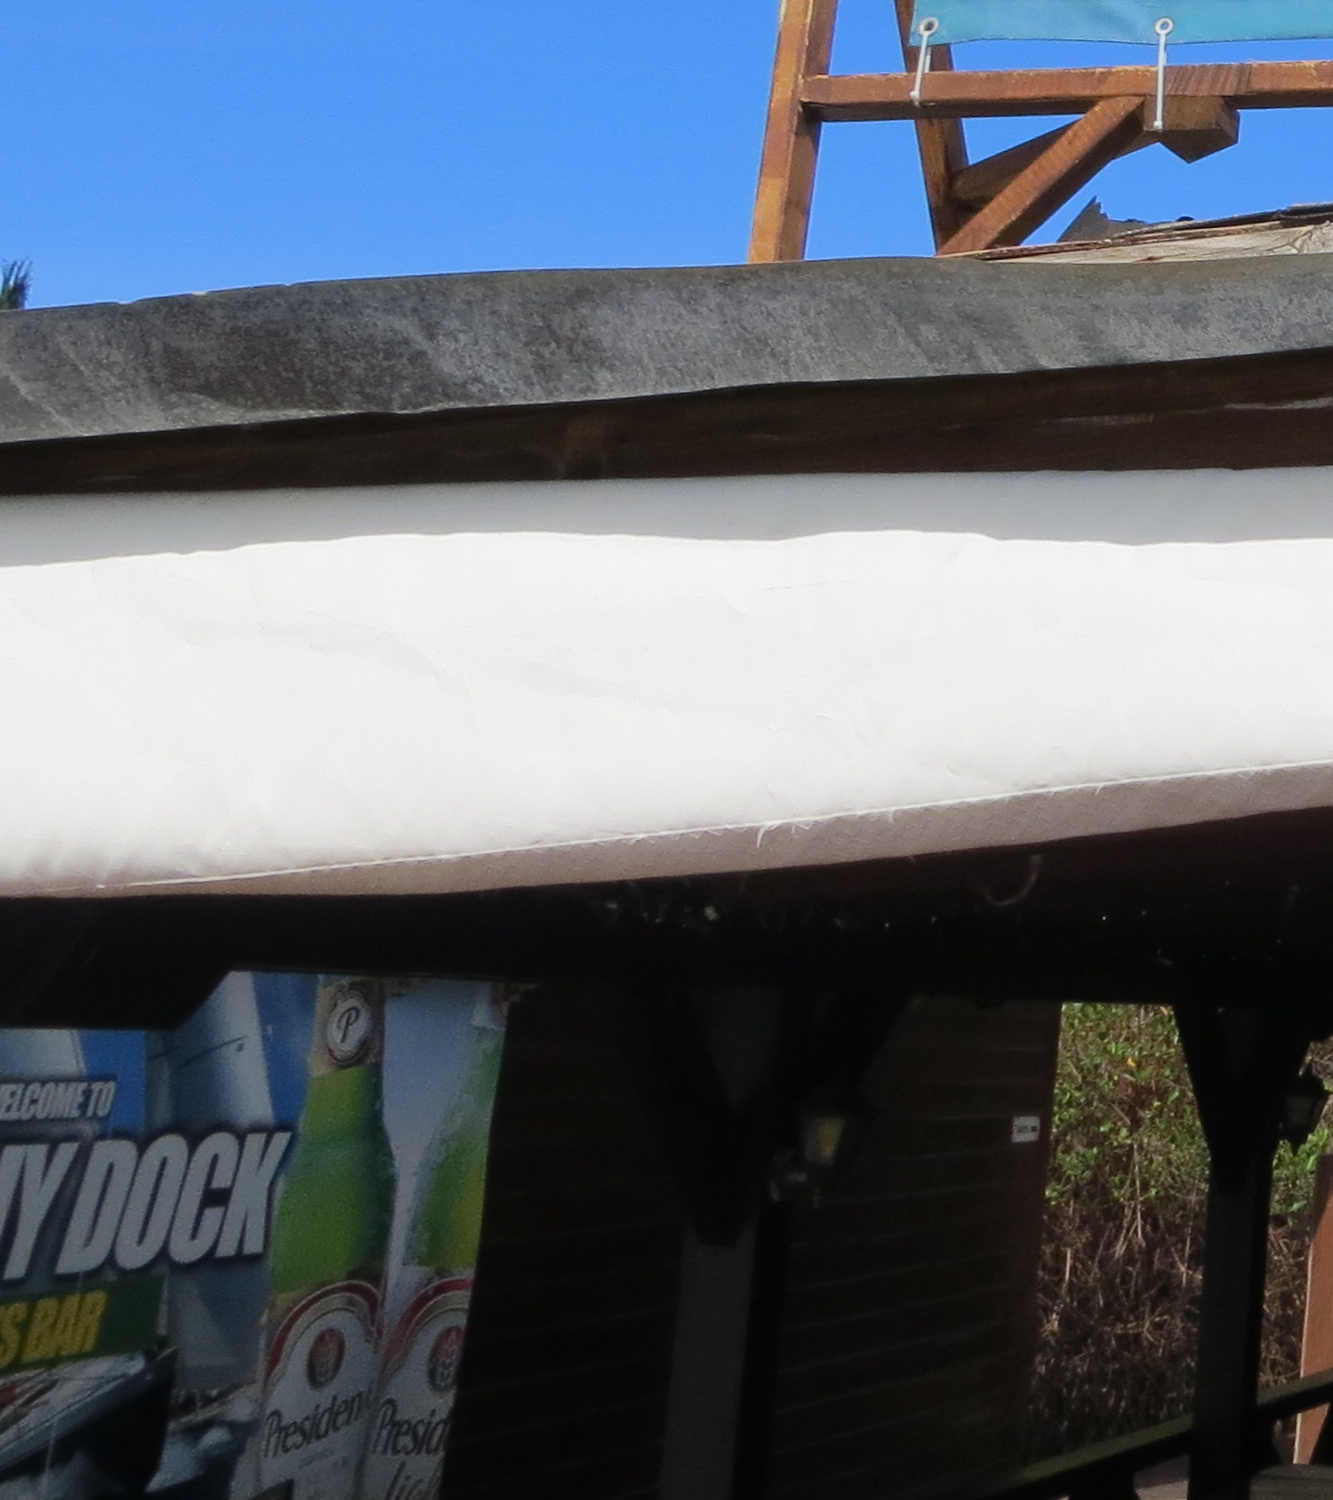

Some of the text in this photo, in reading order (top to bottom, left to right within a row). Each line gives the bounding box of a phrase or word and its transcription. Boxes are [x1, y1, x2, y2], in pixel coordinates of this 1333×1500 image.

[0, 1080, 116, 1121] ELCOME TO
[54, 1131, 291, 1276] DOCK
[20, 1289, 108, 1363] BAR
